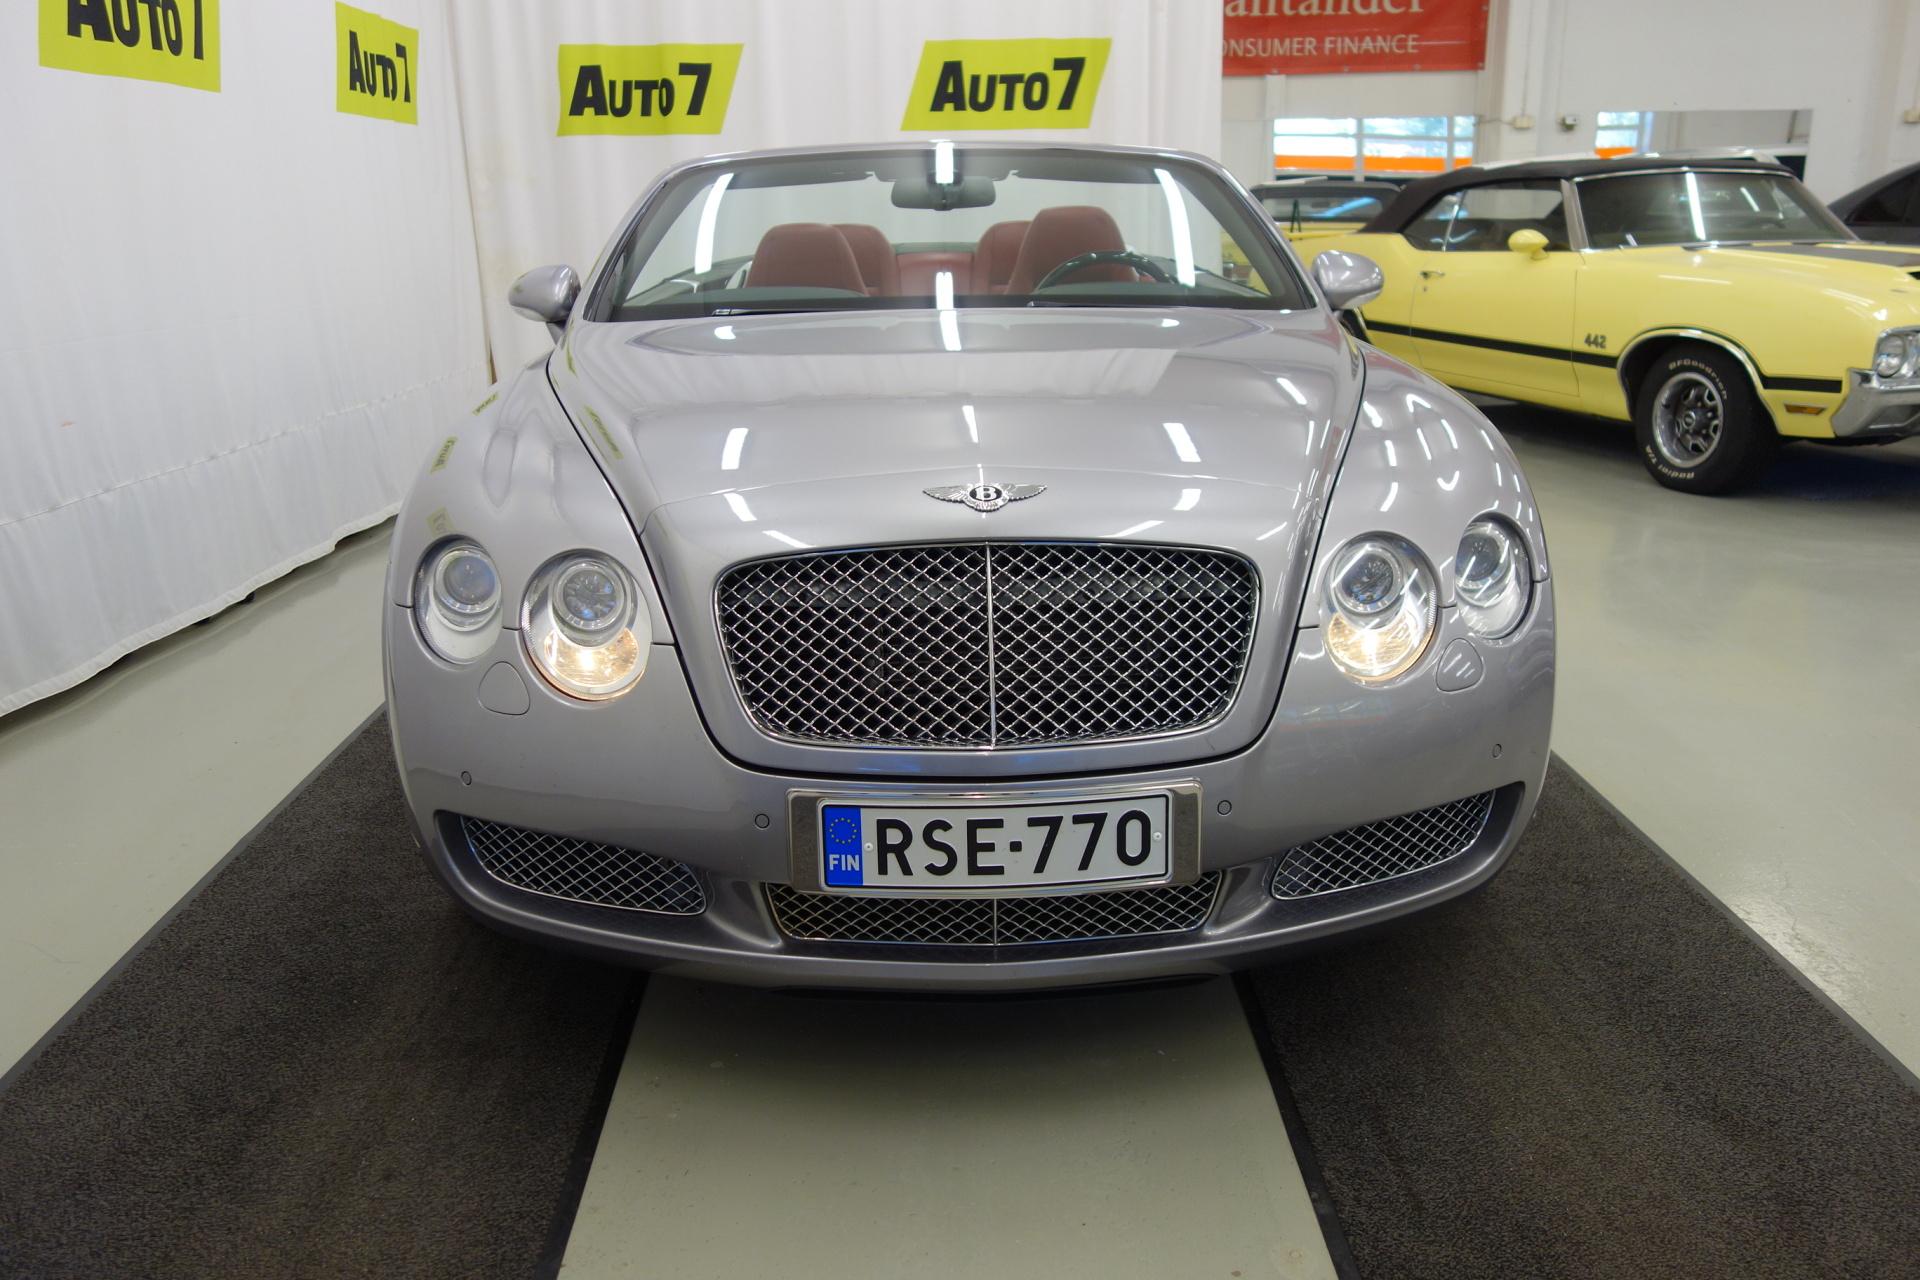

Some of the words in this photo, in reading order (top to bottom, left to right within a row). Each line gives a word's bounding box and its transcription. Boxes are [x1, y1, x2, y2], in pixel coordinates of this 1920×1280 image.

[1324, 34, 1419, 56] FINANCE
[1584, 333, 1606, 349] 442
[975, 485, 997, 501] B
[829, 853, 860, 872] FIN
